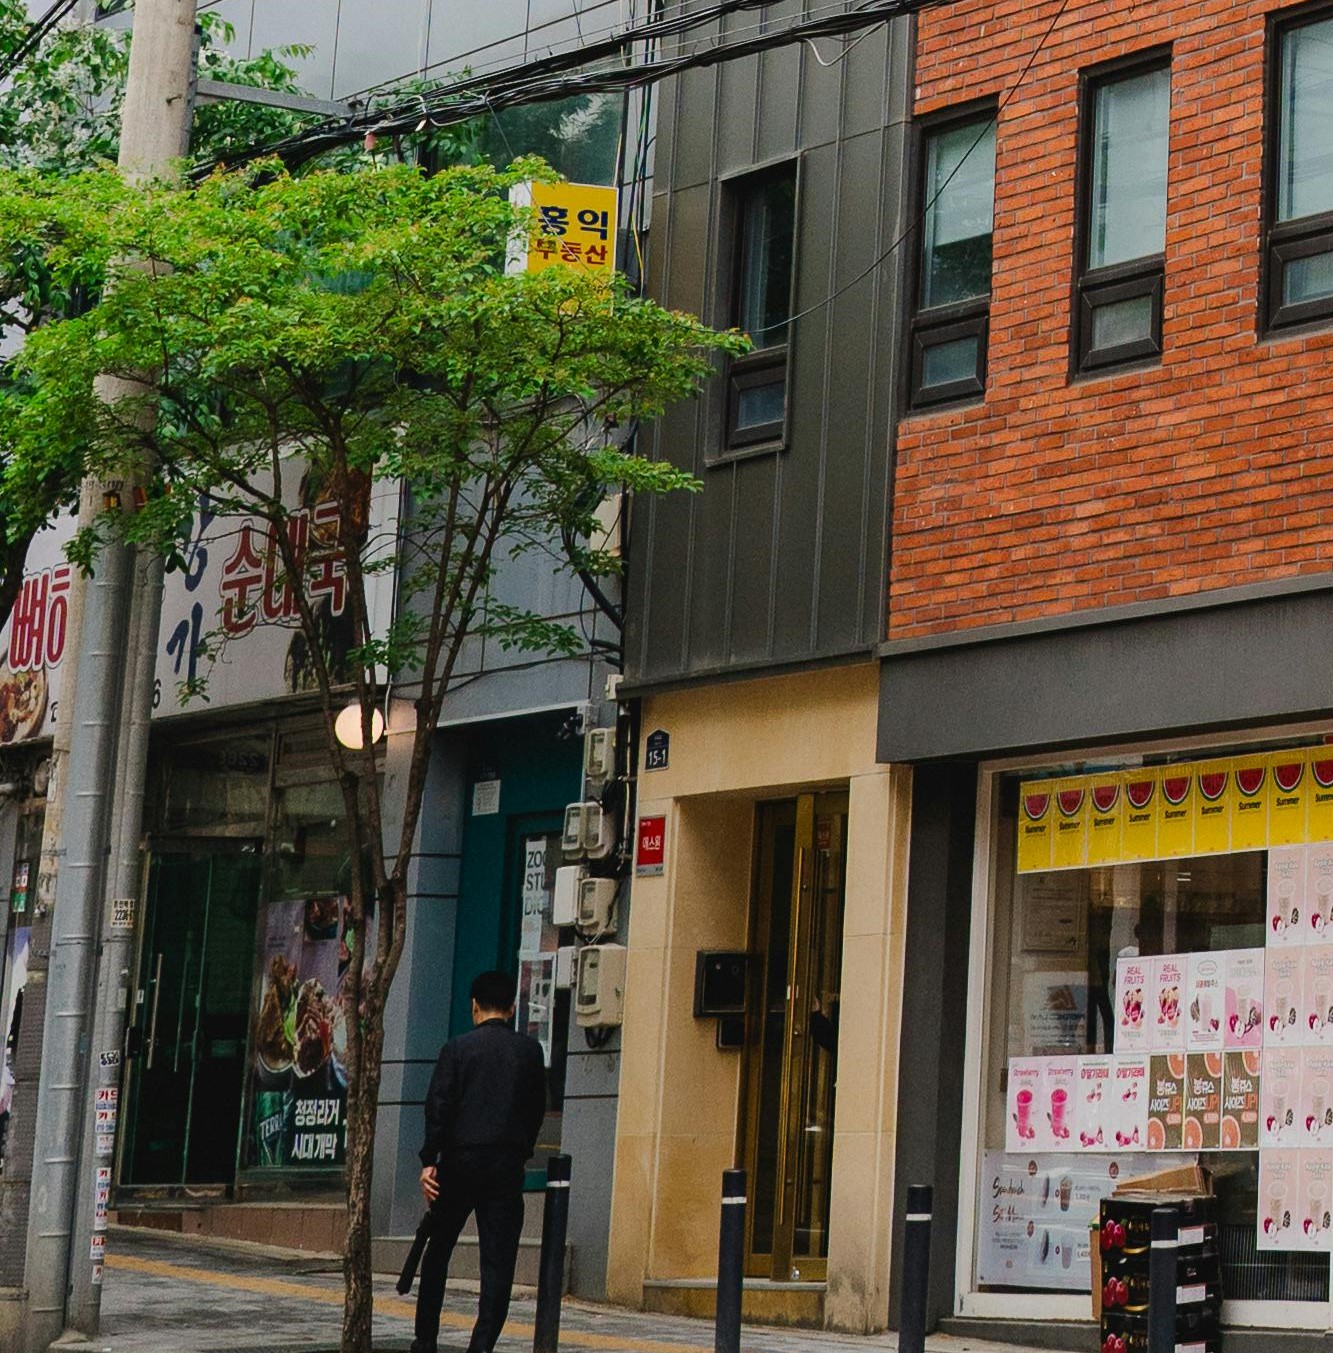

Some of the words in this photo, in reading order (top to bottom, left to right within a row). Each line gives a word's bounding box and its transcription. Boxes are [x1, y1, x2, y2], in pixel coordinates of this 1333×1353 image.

[538, 206, 608, 240] 홍익
[535, 239, 608, 265] 부동산
[648, 748, 666, 766] 15-1
[1238, 800, 1262, 811] Summer
[1276, 797, 1300, 807] Summer
[1165, 808, 1187, 819] Summer
[1201, 804, 1224, 815] Summer
[1093, 817, 1115, 828] Summer
[1129, 813, 1151, 824] Summer
[1025, 824, 1046, 834] Summer
[1059, 821, 1080, 832] Summer
[642, 836, 661, 850] 에스원
[295, 1099, 340, 1126] 청정라거
[291, 1133, 337, 1160] 시대개막
